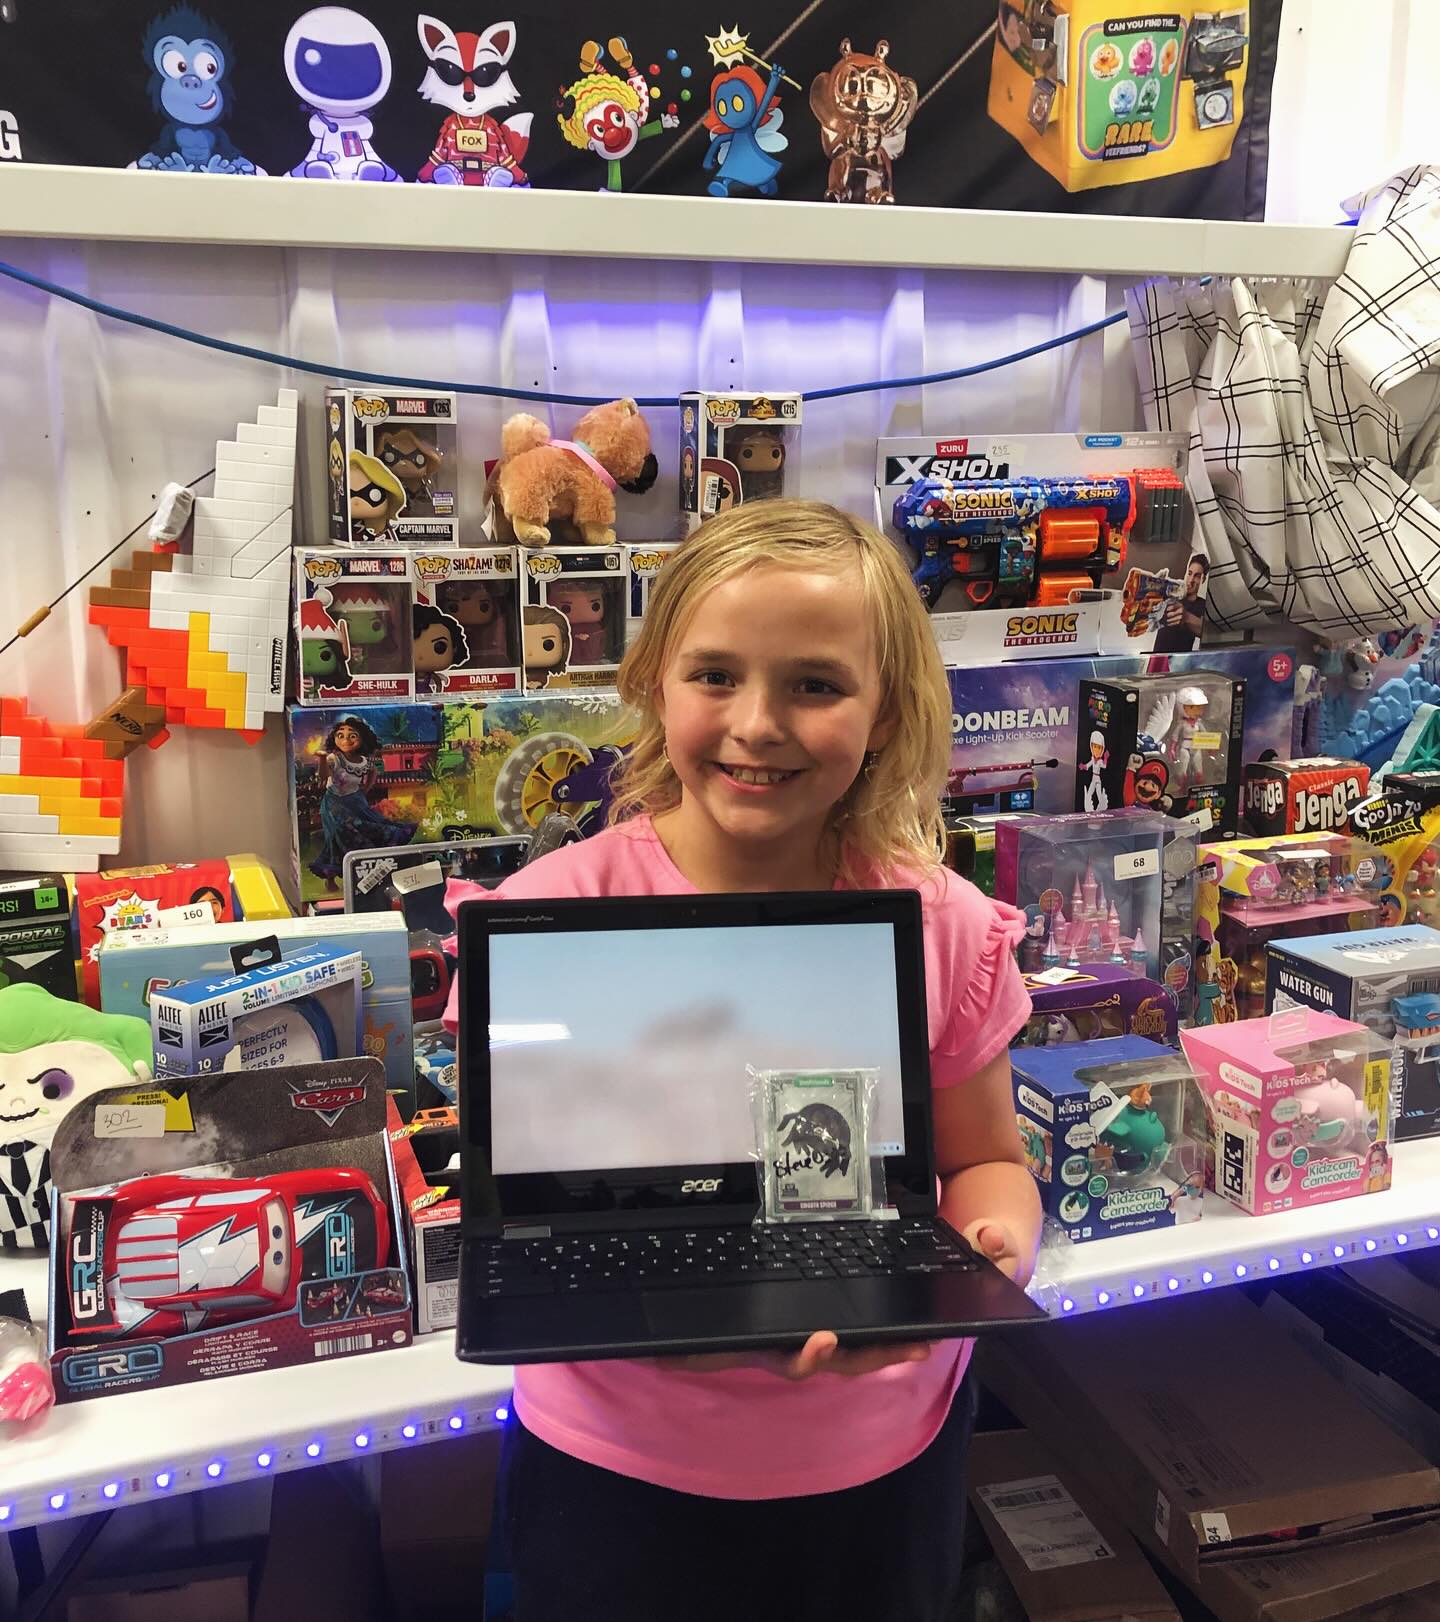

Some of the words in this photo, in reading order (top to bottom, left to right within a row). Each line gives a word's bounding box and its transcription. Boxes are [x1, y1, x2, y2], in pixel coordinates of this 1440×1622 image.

[1108, 22, 1125, 31] CAN
[1127, 20, 1144, 29] YOU
[1144, 19, 1161, 27] FIND
[462, 136, 482, 145] FOX
[352, 398, 389, 418] POP!
[397, 400, 426, 413] MARVEL
[705, 400, 740, 417] POP!
[783, 403, 795, 415] 1215
[940, 445, 964, 454] ZURU
[955, 491, 1013, 510] SONIC
[399, 524, 424, 534] CAPTAIN
[426, 524, 451, 534] MARVEL
[304, 559, 342, 579] POP!
[349, 560, 381, 573] MARVEL
[414, 556, 451, 575] POP!
[453, 556, 493, 571] SHAZAM!
[527, 557, 561, 576] POP!
[1006, 613, 1079, 637] SONIC
[1005, 638, 1022, 646] THE
[1026, 634, 1077, 645] HEDGEHOG
[271, 637, 284, 694] MINECRAFT
[1272, 660, 1288, 672] 5+
[357, 680, 398, 690] SHE-HULK
[469, 675, 498, 684] DARLA
[110, 713, 142, 735] NERF
[965, 733, 1005, 746] Light-Up
[1005, 732, 1022, 740] Kick
[1025, 729, 1059, 740] Scooter
[1308, 778, 1334, 793] Classic
[1247, 779, 1284, 815] Jenga
[1294, 776, 1361, 833] Jenga
[1133, 857, 1145, 867] 68
[183, 908, 203, 921] 160
[0, 927, 63, 942] PORTAL
[205, 971, 253, 993] JUST
[304, 964, 337, 984] SAFE
[243, 998, 271, 1011] VOLUME
[299, 976, 338, 993] HEADPHONES
[1279, 970, 1312, 1001] WATER
[1313, 985, 1334, 1007] GUN
[158, 1004, 182, 1026] ALTEC
[198, 1001, 228, 1026] ALTEC
[240, 1024, 288, 1048] PERFECTLY
[155, 1052, 167, 1065] 10
[241, 1046, 268, 1064] SIZED
[269, 1038, 288, 1053] FOR
[270, 1053, 285, 1066] 6-9
[198, 1058, 212, 1071] 10
[330, 1077, 353, 1085] PIXAR
[1390, 1077, 1403, 1120] WATER
[103, 1109, 137, 1128] 302
[1309, 1160, 1356, 1177] Kidzcam
[681, 1178, 723, 1193] acer
[1303, 1169, 1361, 1189] Camcorder
[1108, 1188, 1161, 1207] Kidzcam
[1101, 1198, 1168, 1219] Camcorder
[329, 1215, 347, 1276] GRC
[72, 1231, 97, 1319] GRC
[204, 1334, 227, 1343] DRIFT
[236, 1330, 259, 1338] RACE
[1205, 1526, 1220, 1543] 84
